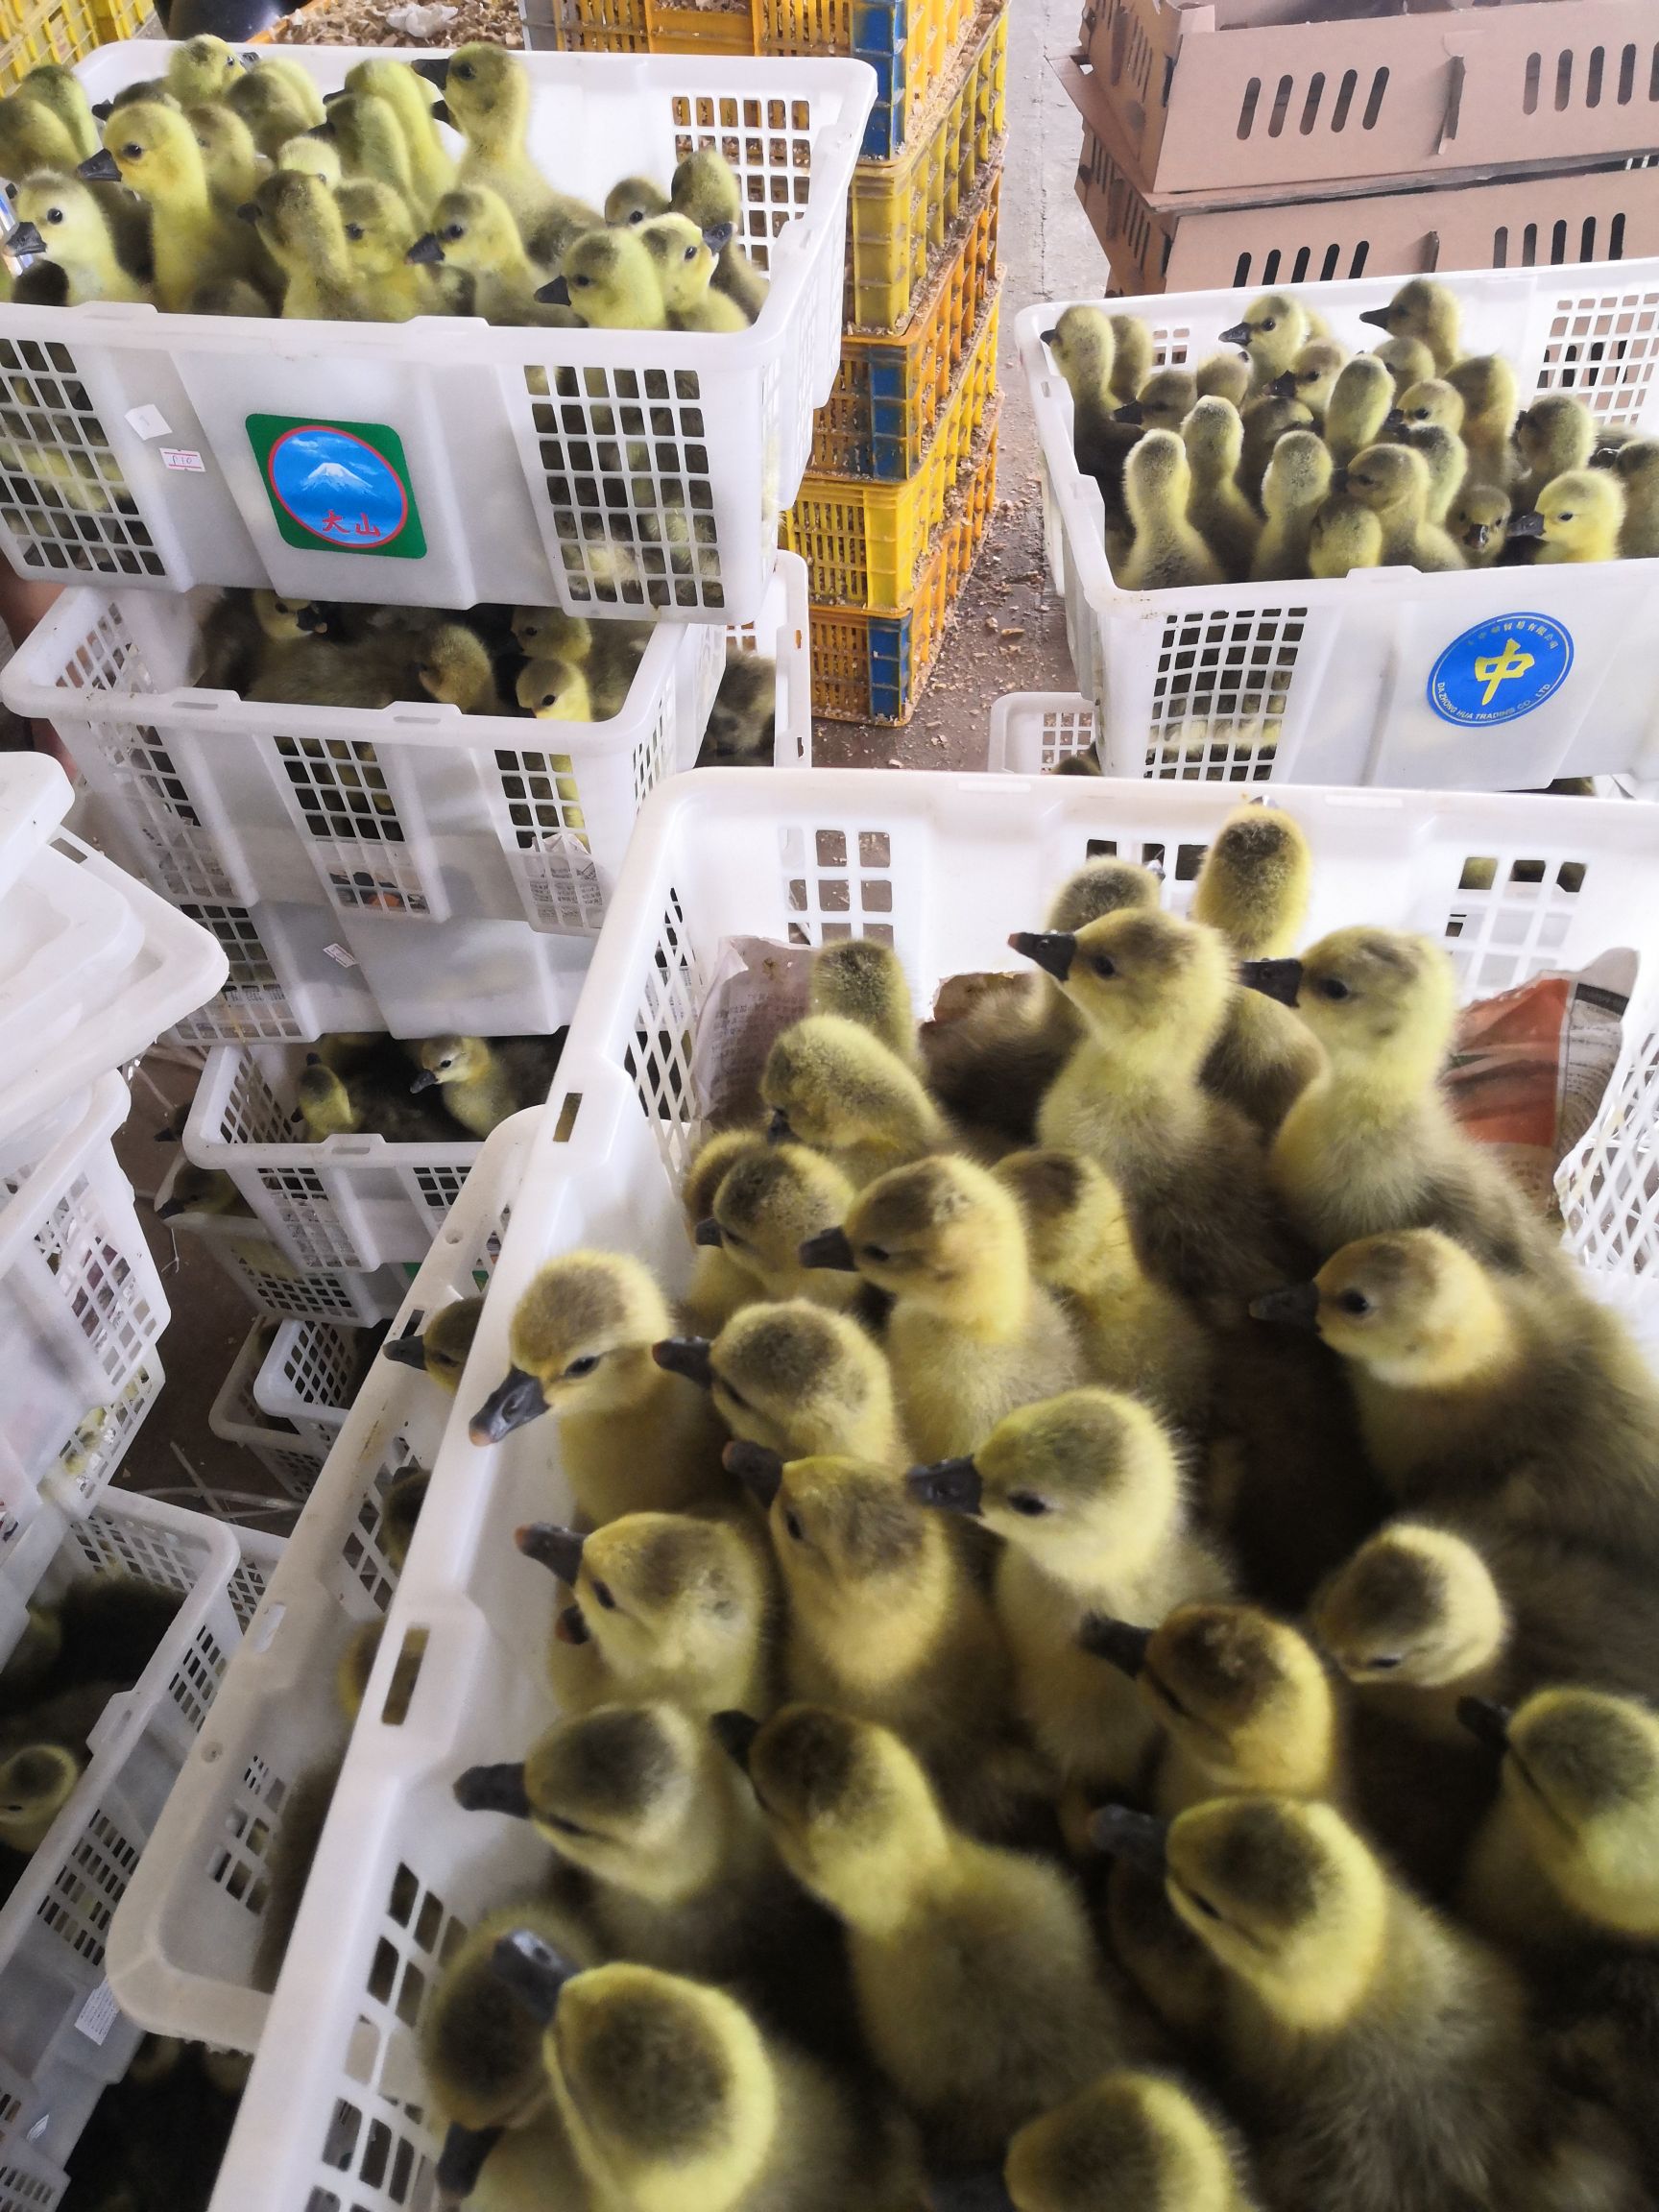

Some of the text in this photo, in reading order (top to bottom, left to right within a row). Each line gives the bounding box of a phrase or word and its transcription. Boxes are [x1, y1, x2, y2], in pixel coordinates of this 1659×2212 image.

[322, 509, 381, 537] 大山
[1475, 637, 1535, 706] 中
[1456, 709, 1474, 720] HUA
